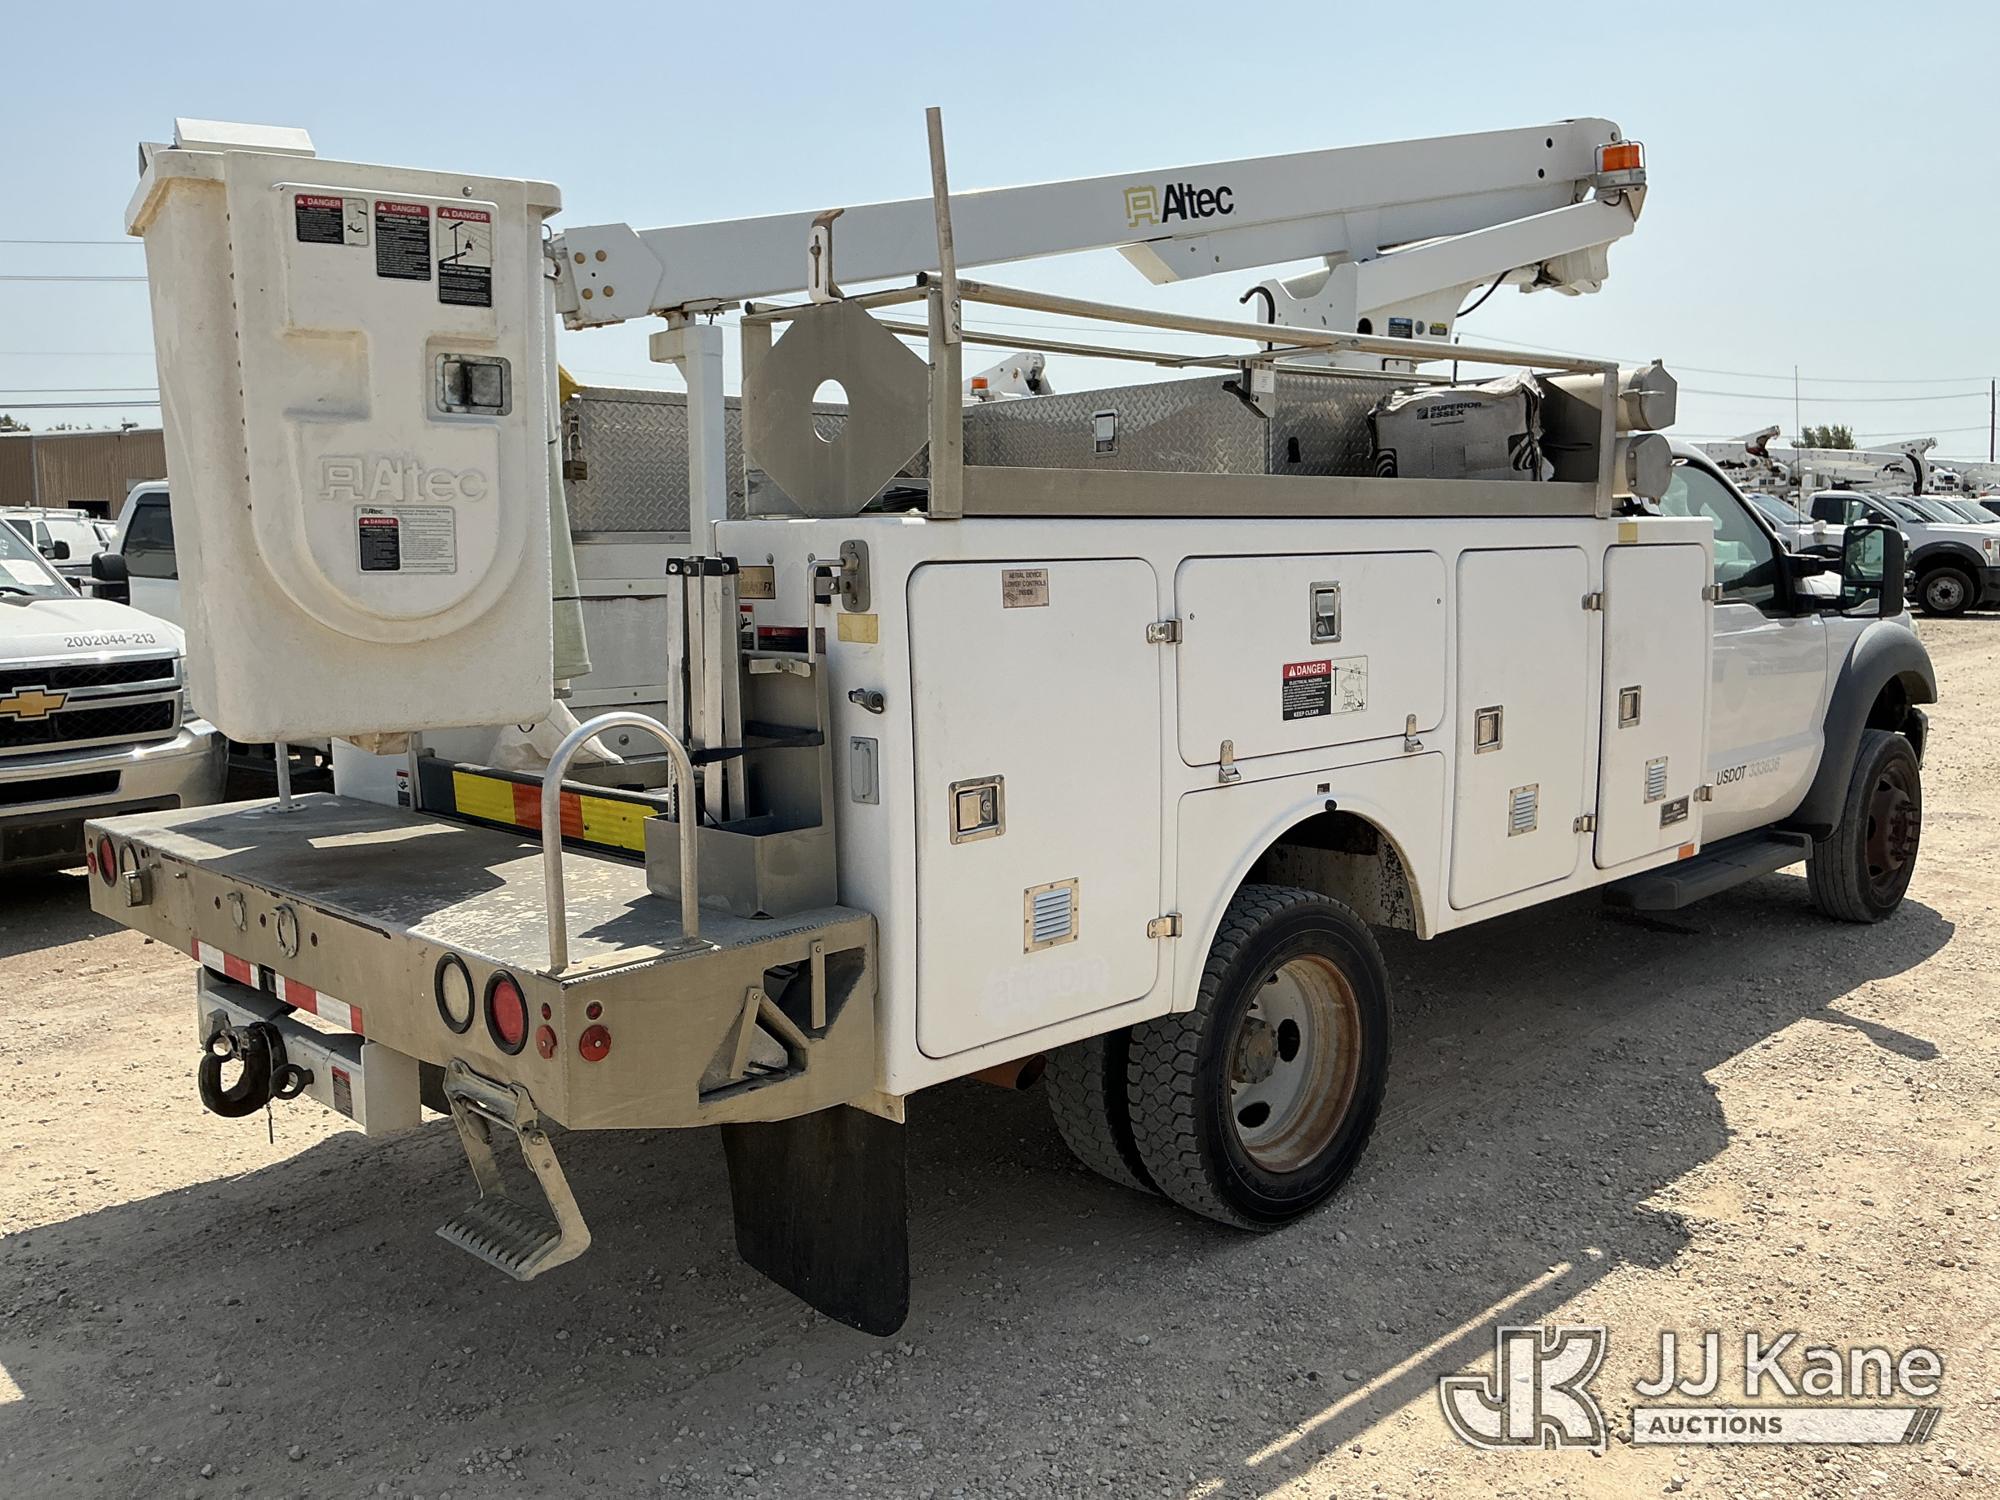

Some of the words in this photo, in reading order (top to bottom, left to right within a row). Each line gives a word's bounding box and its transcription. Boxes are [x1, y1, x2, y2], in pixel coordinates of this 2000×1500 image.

[307, 197, 341, 207] DANGER
[391, 203, 421, 213] DANGER
[1161, 182, 1235, 223] Altec
[451, 210, 487, 221] DANGER
[1430, 401, 1482, 412] SUPERIOR
[1430, 409, 1464, 419] ESSEX
[370, 456, 488, 502] Altec
[64, 633, 156, 648] 2002044-213
[1296, 663, 1327, 676] DANGER
[1716, 765, 1747, 786] USDOT
